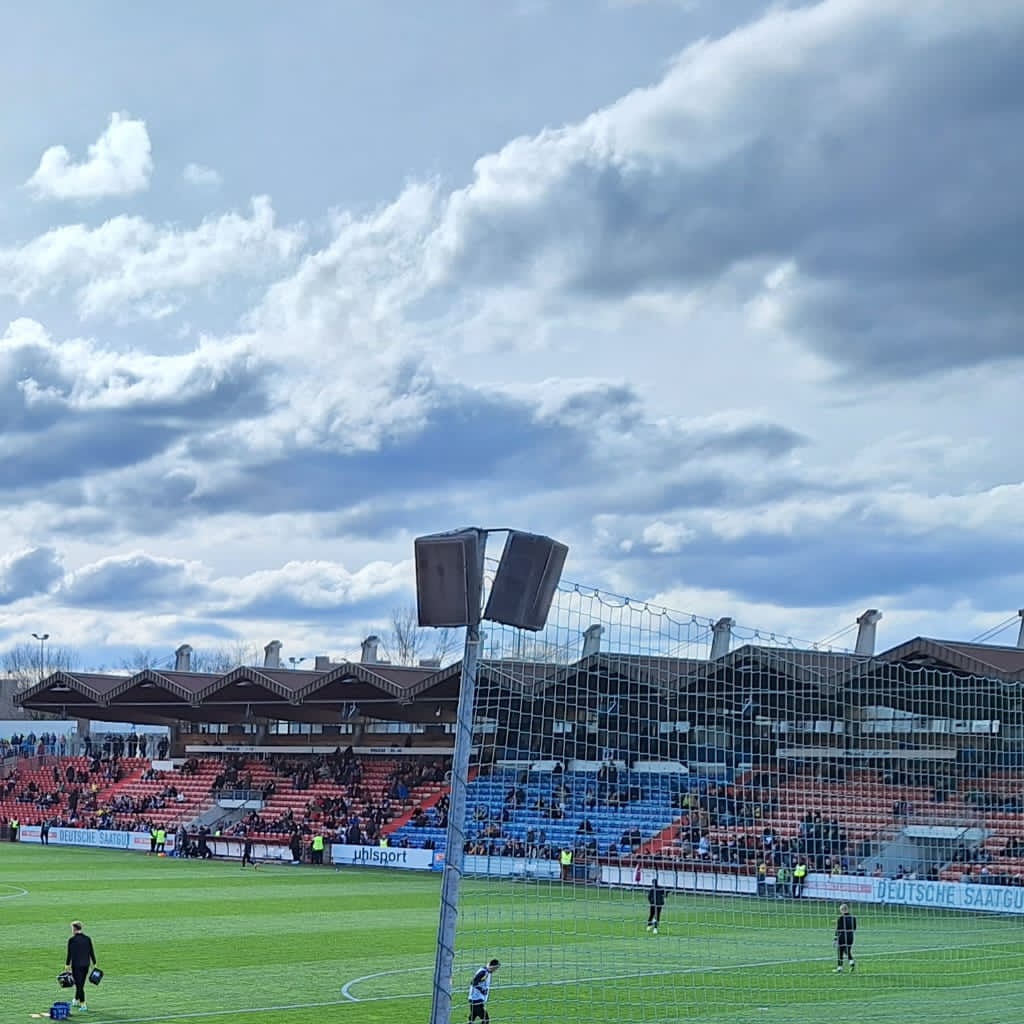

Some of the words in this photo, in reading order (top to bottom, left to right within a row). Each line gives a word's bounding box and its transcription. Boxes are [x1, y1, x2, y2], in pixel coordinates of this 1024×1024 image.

[59, 829, 97, 844] DEUTSCHE
[353, 847, 407, 864] uhlsport
[877, 880, 955, 904] DEUTSCHE
